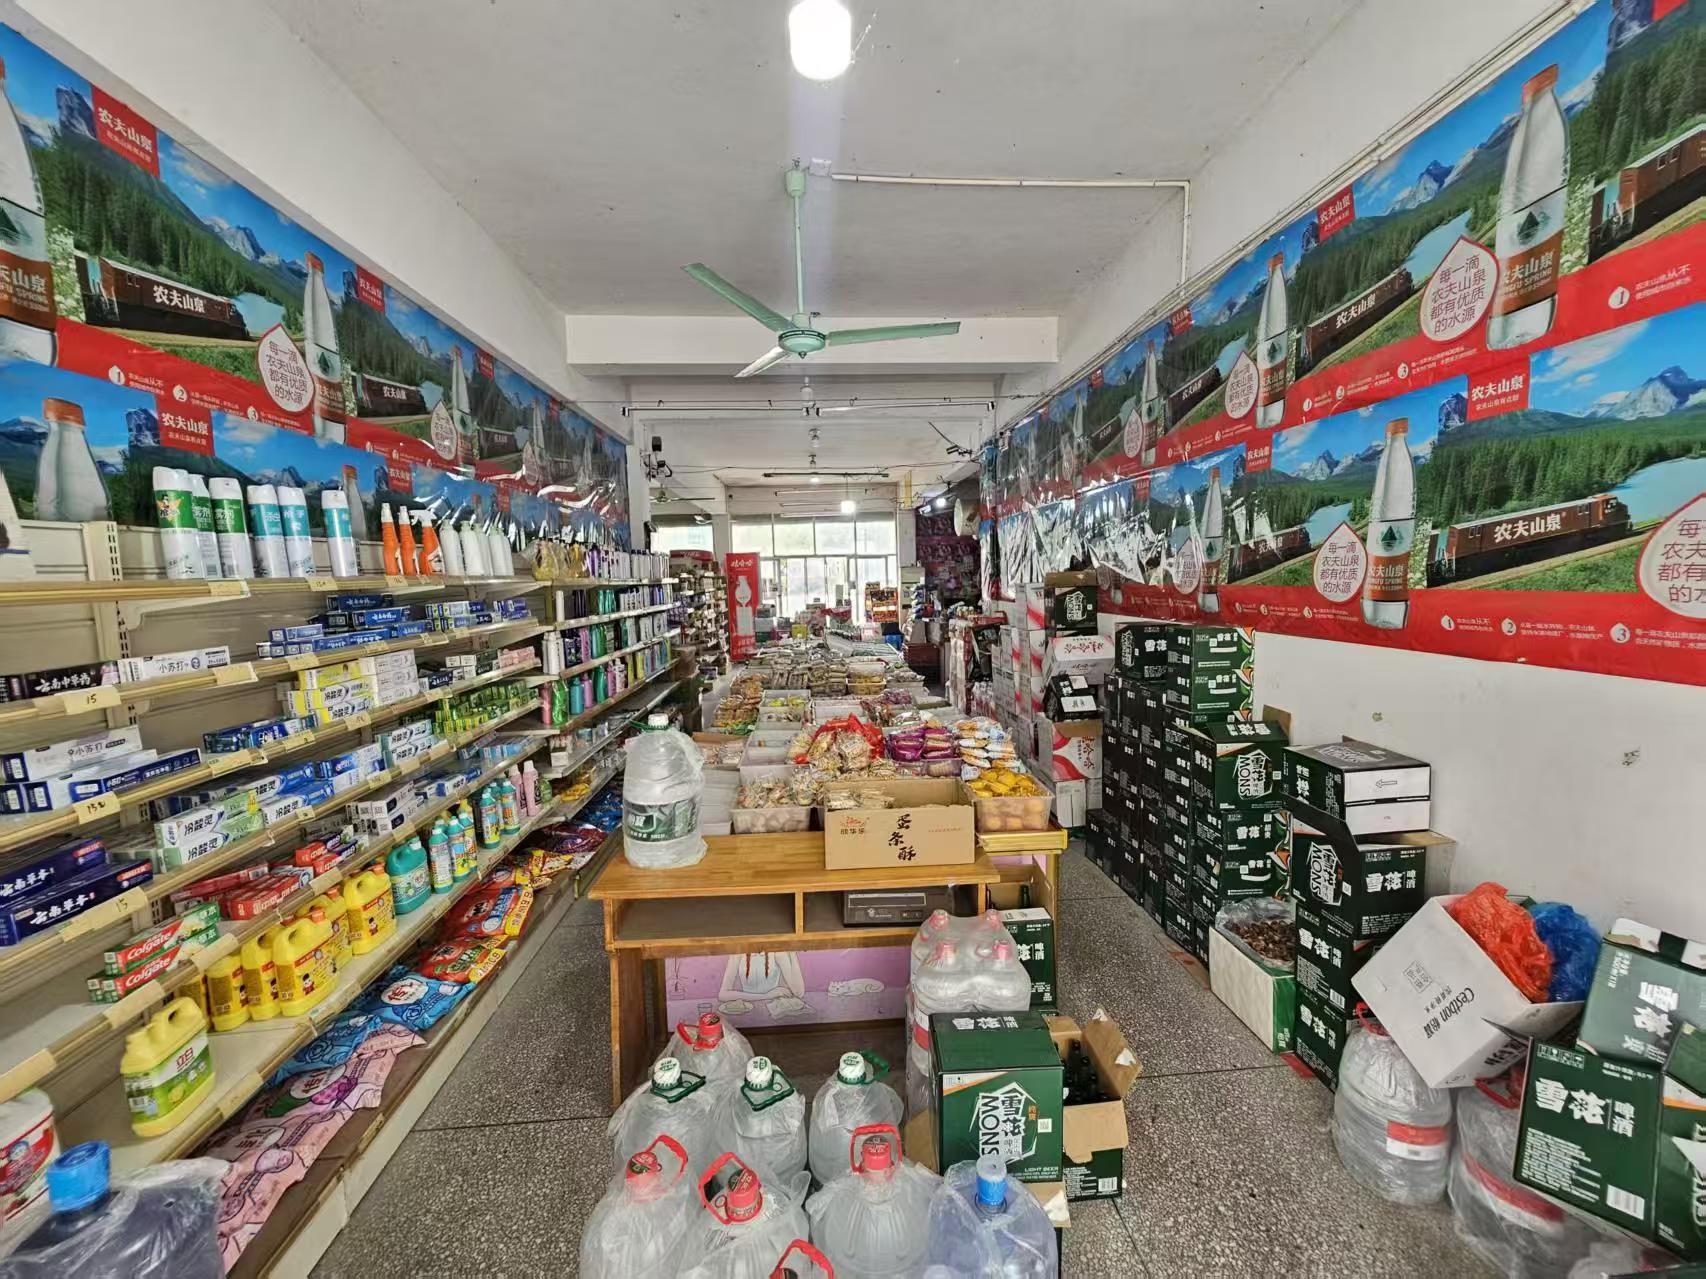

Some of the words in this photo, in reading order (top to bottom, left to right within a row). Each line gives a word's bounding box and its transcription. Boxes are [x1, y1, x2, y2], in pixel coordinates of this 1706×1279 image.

[98, 107, 153, 153] 农夫山泉
[1319, 194, 1350, 224] 农夫山泉
[1439, 254, 1480, 284] 每一滴
[1432, 269, 1486, 301] 农夫山泉
[153, 284, 206, 314] 农夫山泉
[1335, 293, 1376, 329] 农夫山泉
[1430, 286, 1485, 321] 都有优质
[1434, 308, 1476, 335] 的水源
[269, 340, 298, 364] 每一滴
[266, 353, 306, 379] 农夫山泉
[269, 368, 307, 392] 都有优质
[383, 385, 408, 400] 农夫山泉
[1471, 374, 1523, 401] 农夫山泉
[274, 385, 304, 405] 的水源
[161, 413, 208, 436] 农夫山泉
[1247, 445, 1270, 460] 农夫山泉
[1494, 512, 1562, 543] 农夫山泉
[1677, 518, 1706, 538] 每
[1328, 541, 1356, 554] 每一滴
[1322, 554, 1359, 568] 农夫山泉
[1320, 567, 1358, 581] 都有优质
[1323, 581, 1352, 594] 的水源
[1144, 639, 1167, 652] 雪花
[159, 661, 185, 674] 小苏打
[34, 673, 91, 693] 云南中草药
[86, 693, 97, 704] 15
[75, 741, 103, 756] 小苏打
[1239, 755, 1251, 797] SNOW
[184, 813, 214, 836] 冷酸灵
[888, 813, 916, 861] 蛋条酥
[1236, 825, 1260, 840] 雪花
[188, 837, 218, 861] 冷酸灵
[1311, 844, 1323, 898] SNOW
[1365, 870, 1404, 893] 雪花
[116, 897, 128, 912] 15
[127, 931, 172, 960] Colgate
[1298, 927, 1331, 960] 雪花
[125, 957, 170, 987] Colgate
[1300, 1004, 1327, 1039] 雪花
[1633, 982, 1678, 1038] 雪花
[952, 1017, 1001, 1030] 雪花
[1535, 1077, 1605, 1125] 雪花
[981, 1095, 1000, 1156] SNOW
[1001, 1094, 1023, 1137] 雪花
